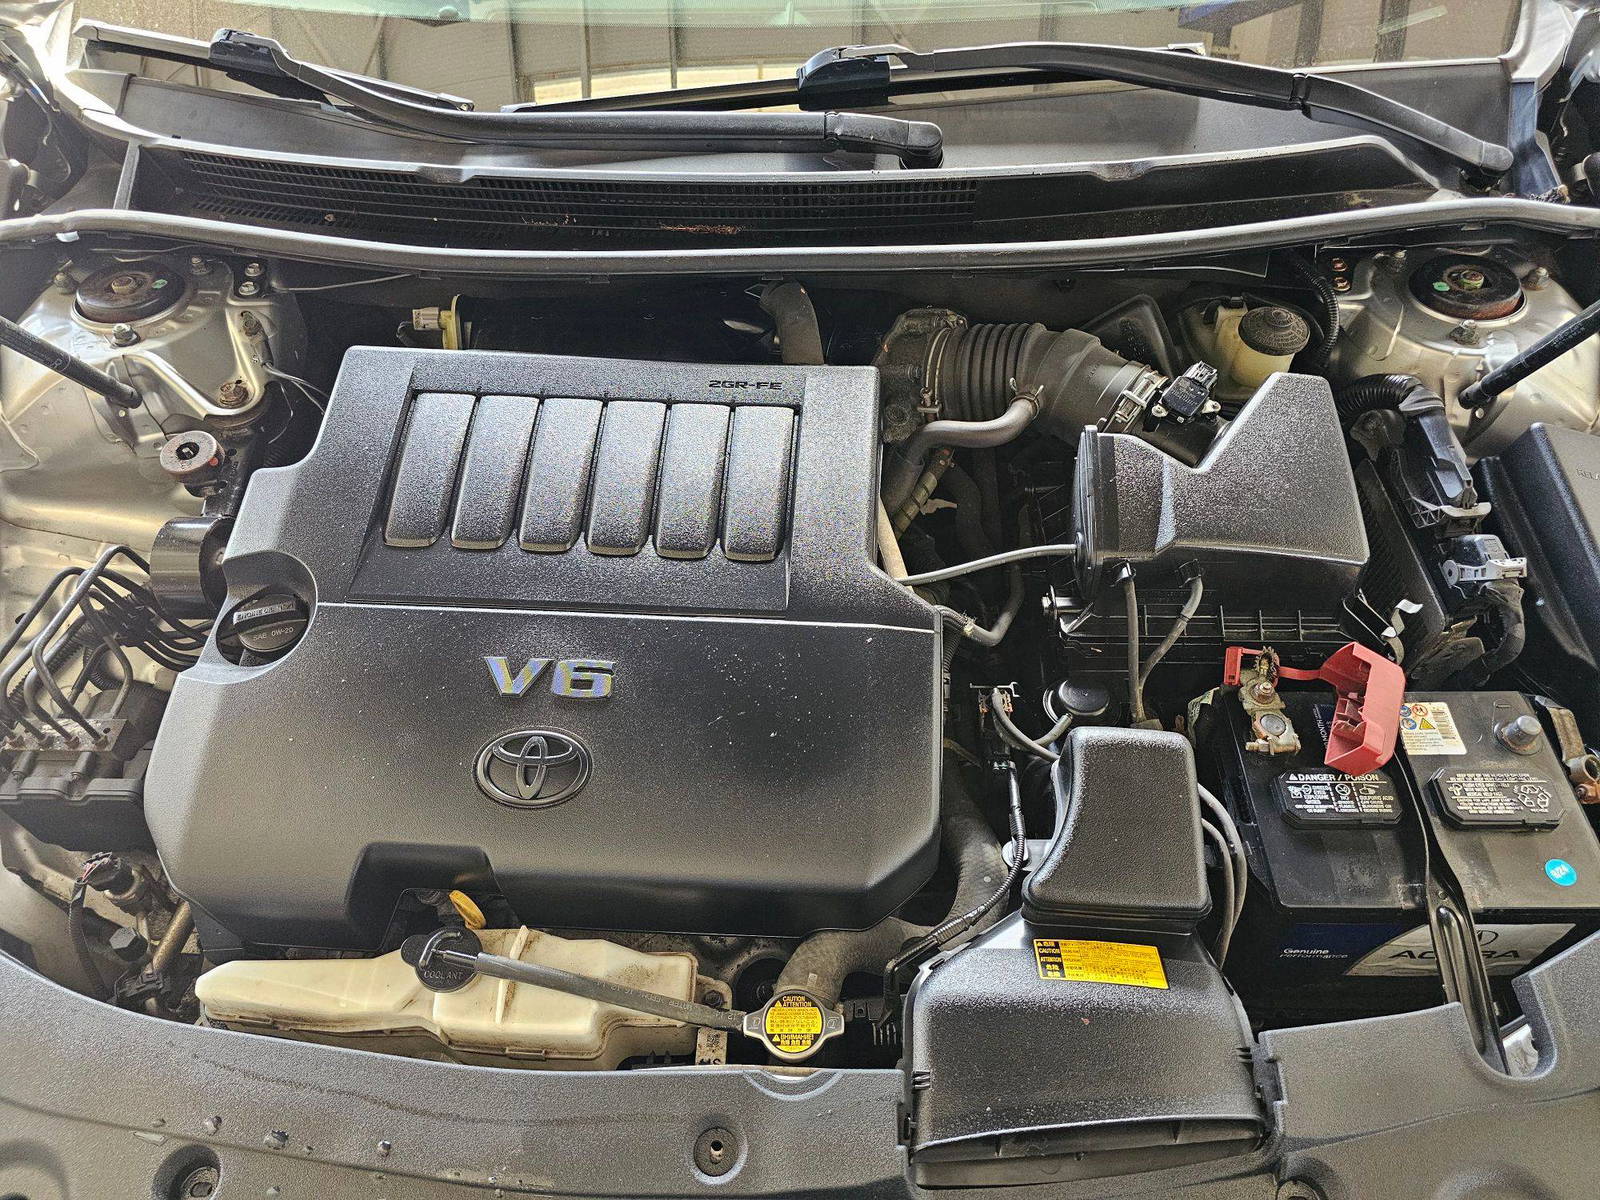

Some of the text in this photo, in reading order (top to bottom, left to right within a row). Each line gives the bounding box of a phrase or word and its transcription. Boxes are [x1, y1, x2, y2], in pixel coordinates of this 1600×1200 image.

[709, 380, 782, 390] 2GR-FE
[253, 627, 294, 641] SAE 0W-20
[483, 656, 615, 699] V6
[1389, 950, 1520, 959] ACRA
[424, 970, 464, 980] COOLANT
